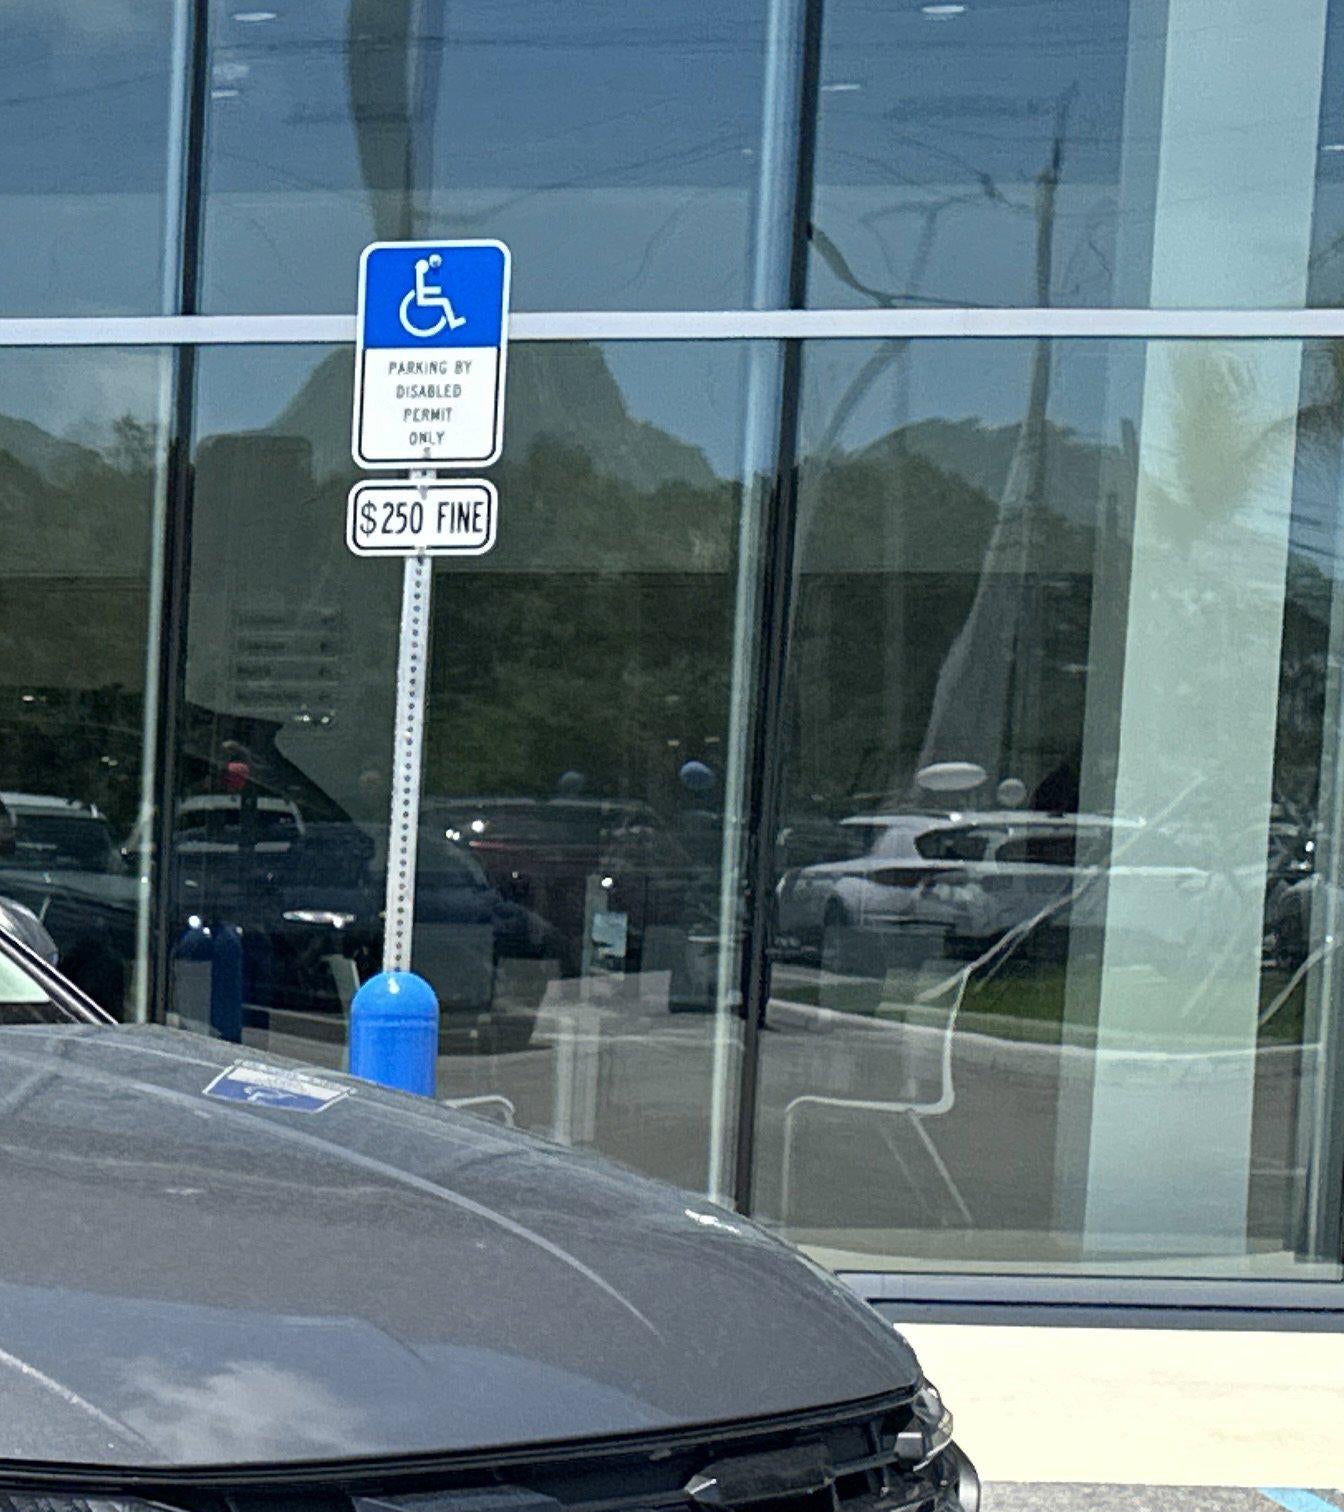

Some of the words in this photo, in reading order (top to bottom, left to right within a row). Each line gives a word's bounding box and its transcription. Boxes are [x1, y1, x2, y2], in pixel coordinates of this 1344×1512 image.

[388, 360, 447, 375] PARKING
[453, 360, 472, 374] BY
[395, 384, 462, 399] DISABLED
[403, 407, 452, 423] PERMIT
[408, 431, 445, 446] ONLY
[359, 499, 423, 537] $250
[437, 501, 485, 534] FINE
